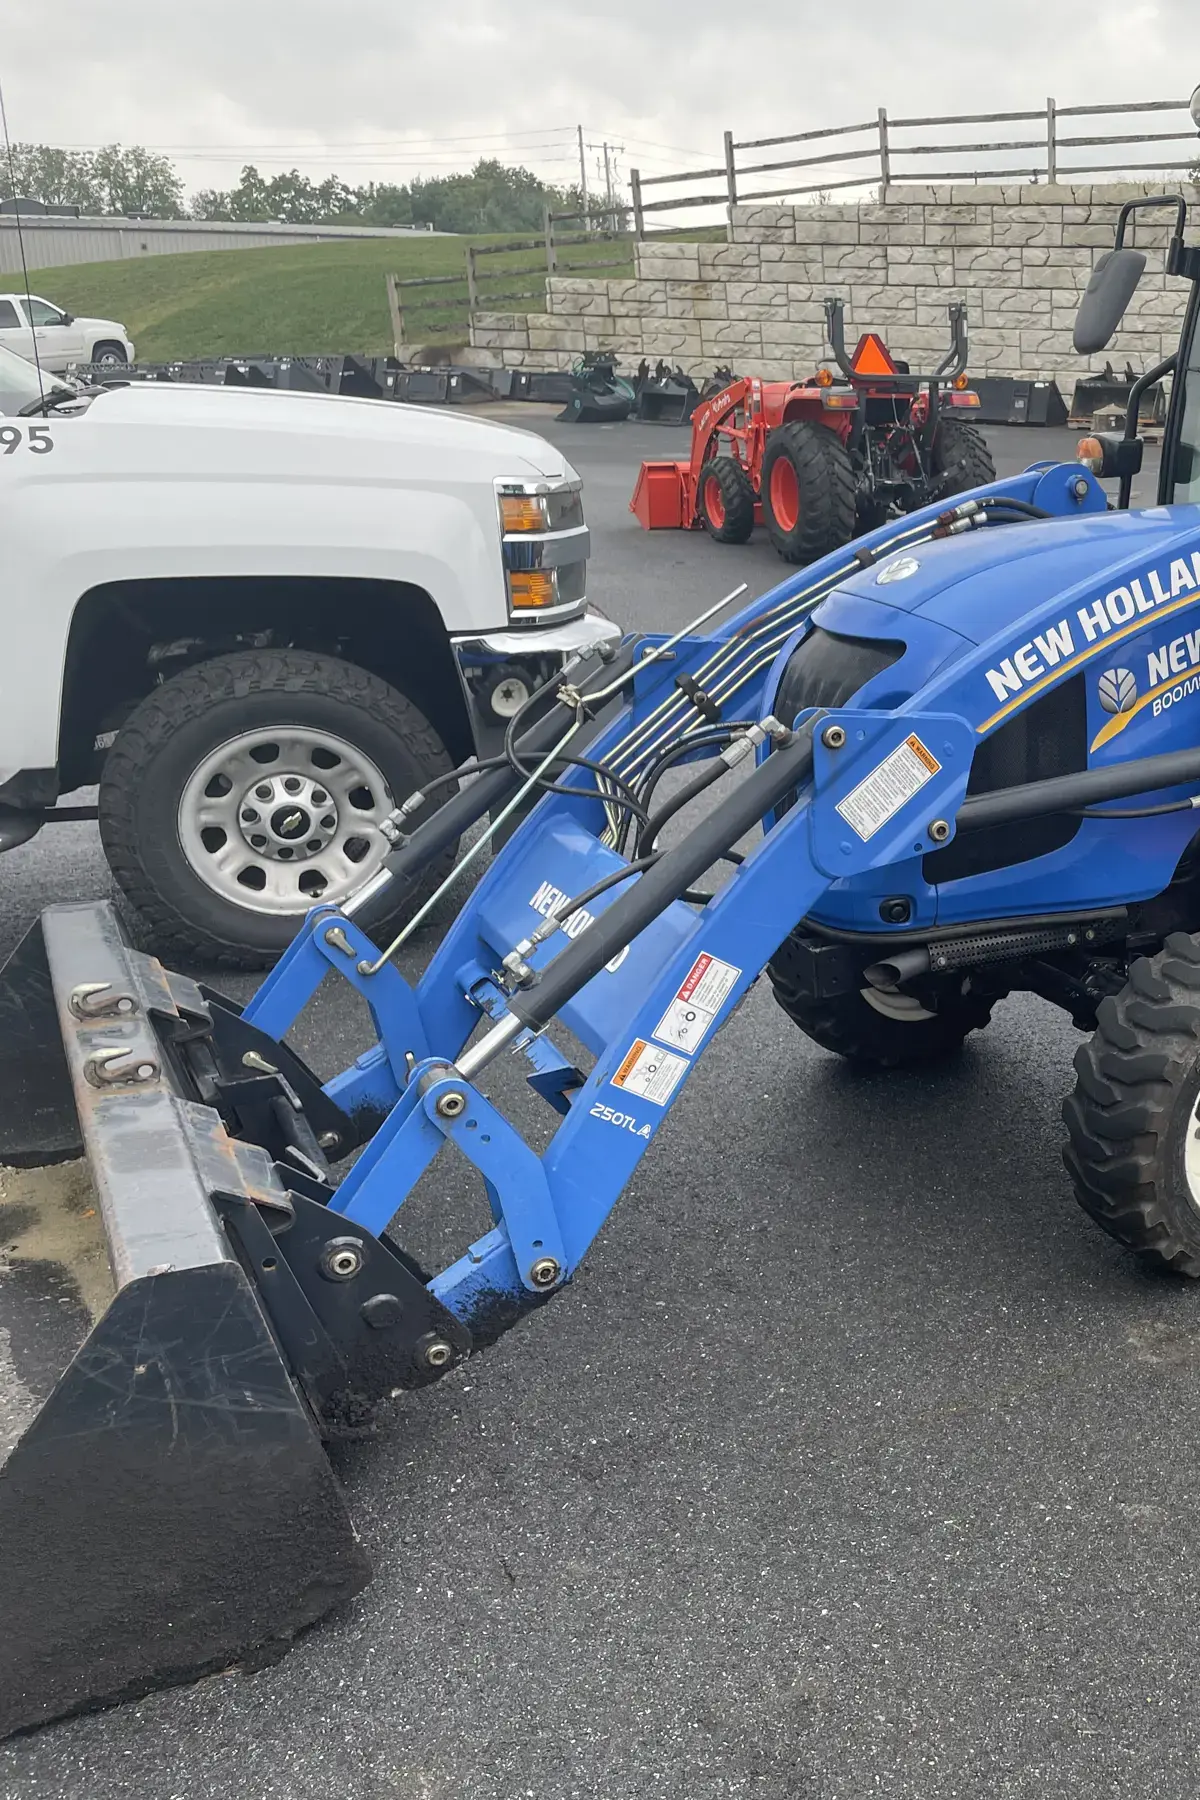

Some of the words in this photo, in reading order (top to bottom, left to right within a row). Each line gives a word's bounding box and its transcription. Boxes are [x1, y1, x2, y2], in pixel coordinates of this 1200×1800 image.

[984, 619, 1075, 702] NEW
[914, 745, 936, 770] WARNING
[686, 957, 708, 990] DANGER
[589, 1102, 652, 1139] 250TLA
